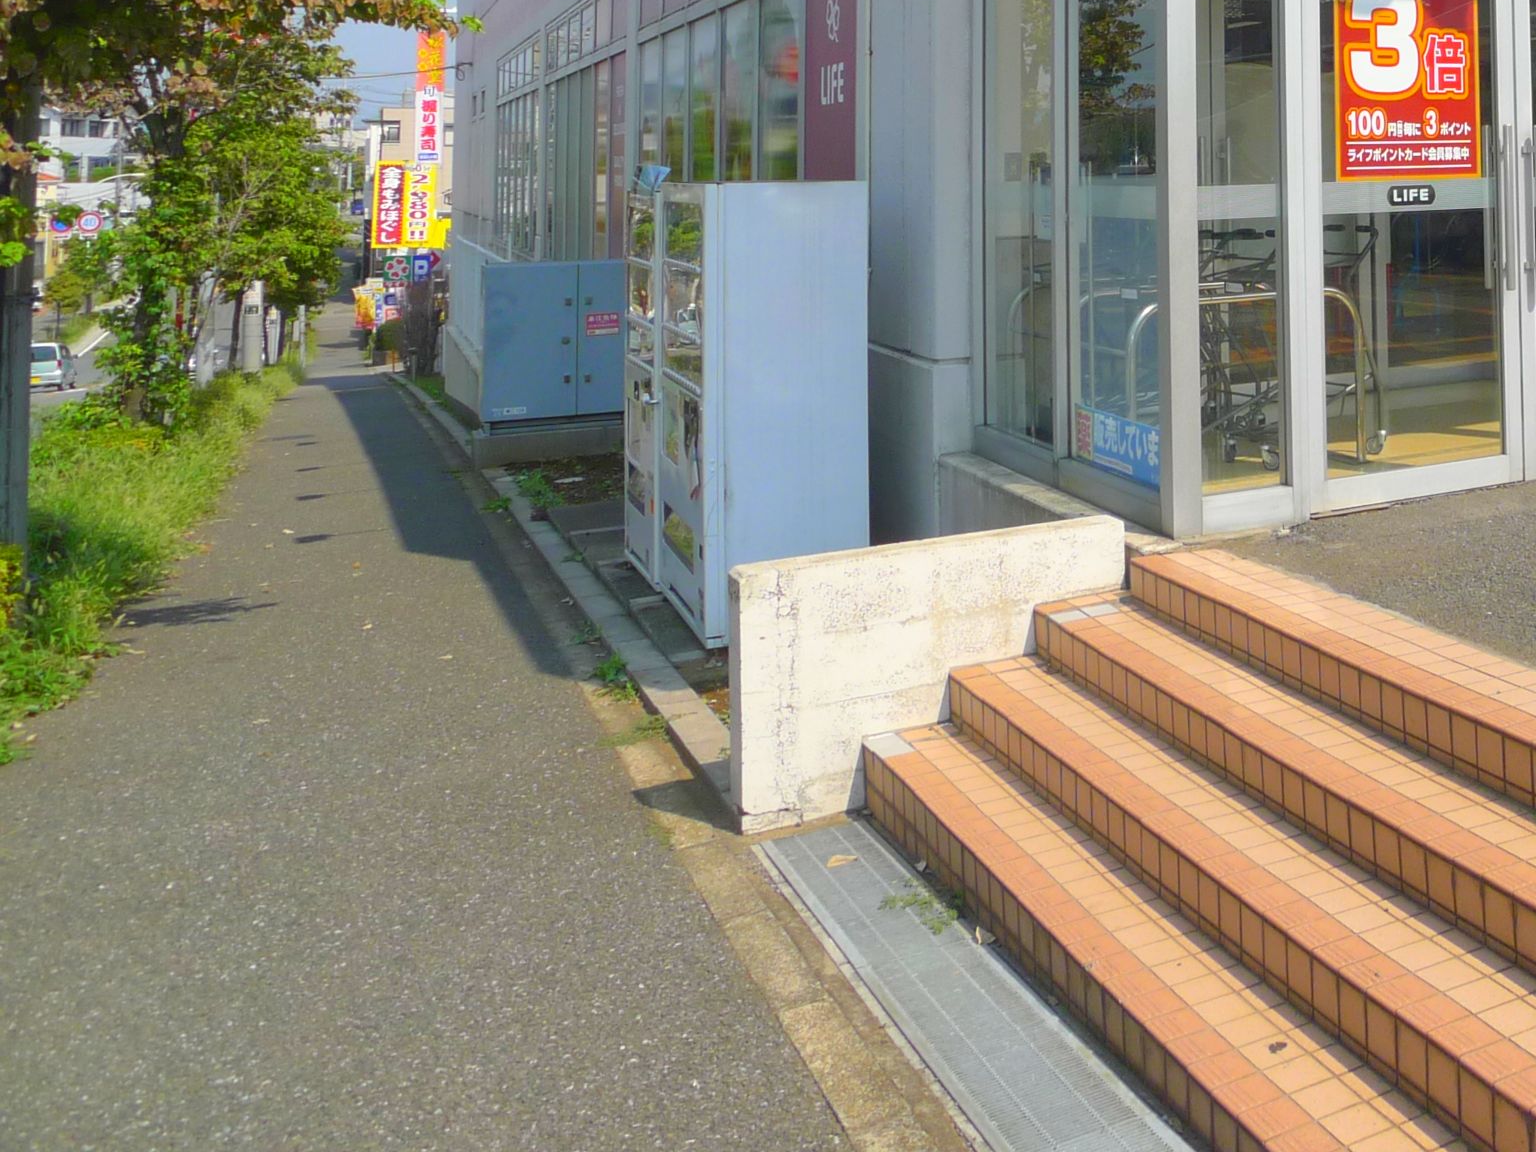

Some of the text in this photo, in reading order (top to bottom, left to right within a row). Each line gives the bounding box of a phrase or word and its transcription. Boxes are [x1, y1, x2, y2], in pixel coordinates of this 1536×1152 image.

[820, 61, 845, 106] LIFE
[380, 165, 402, 244] 全身もみほぐし
[1392, 188, 1430, 202] LIFE
